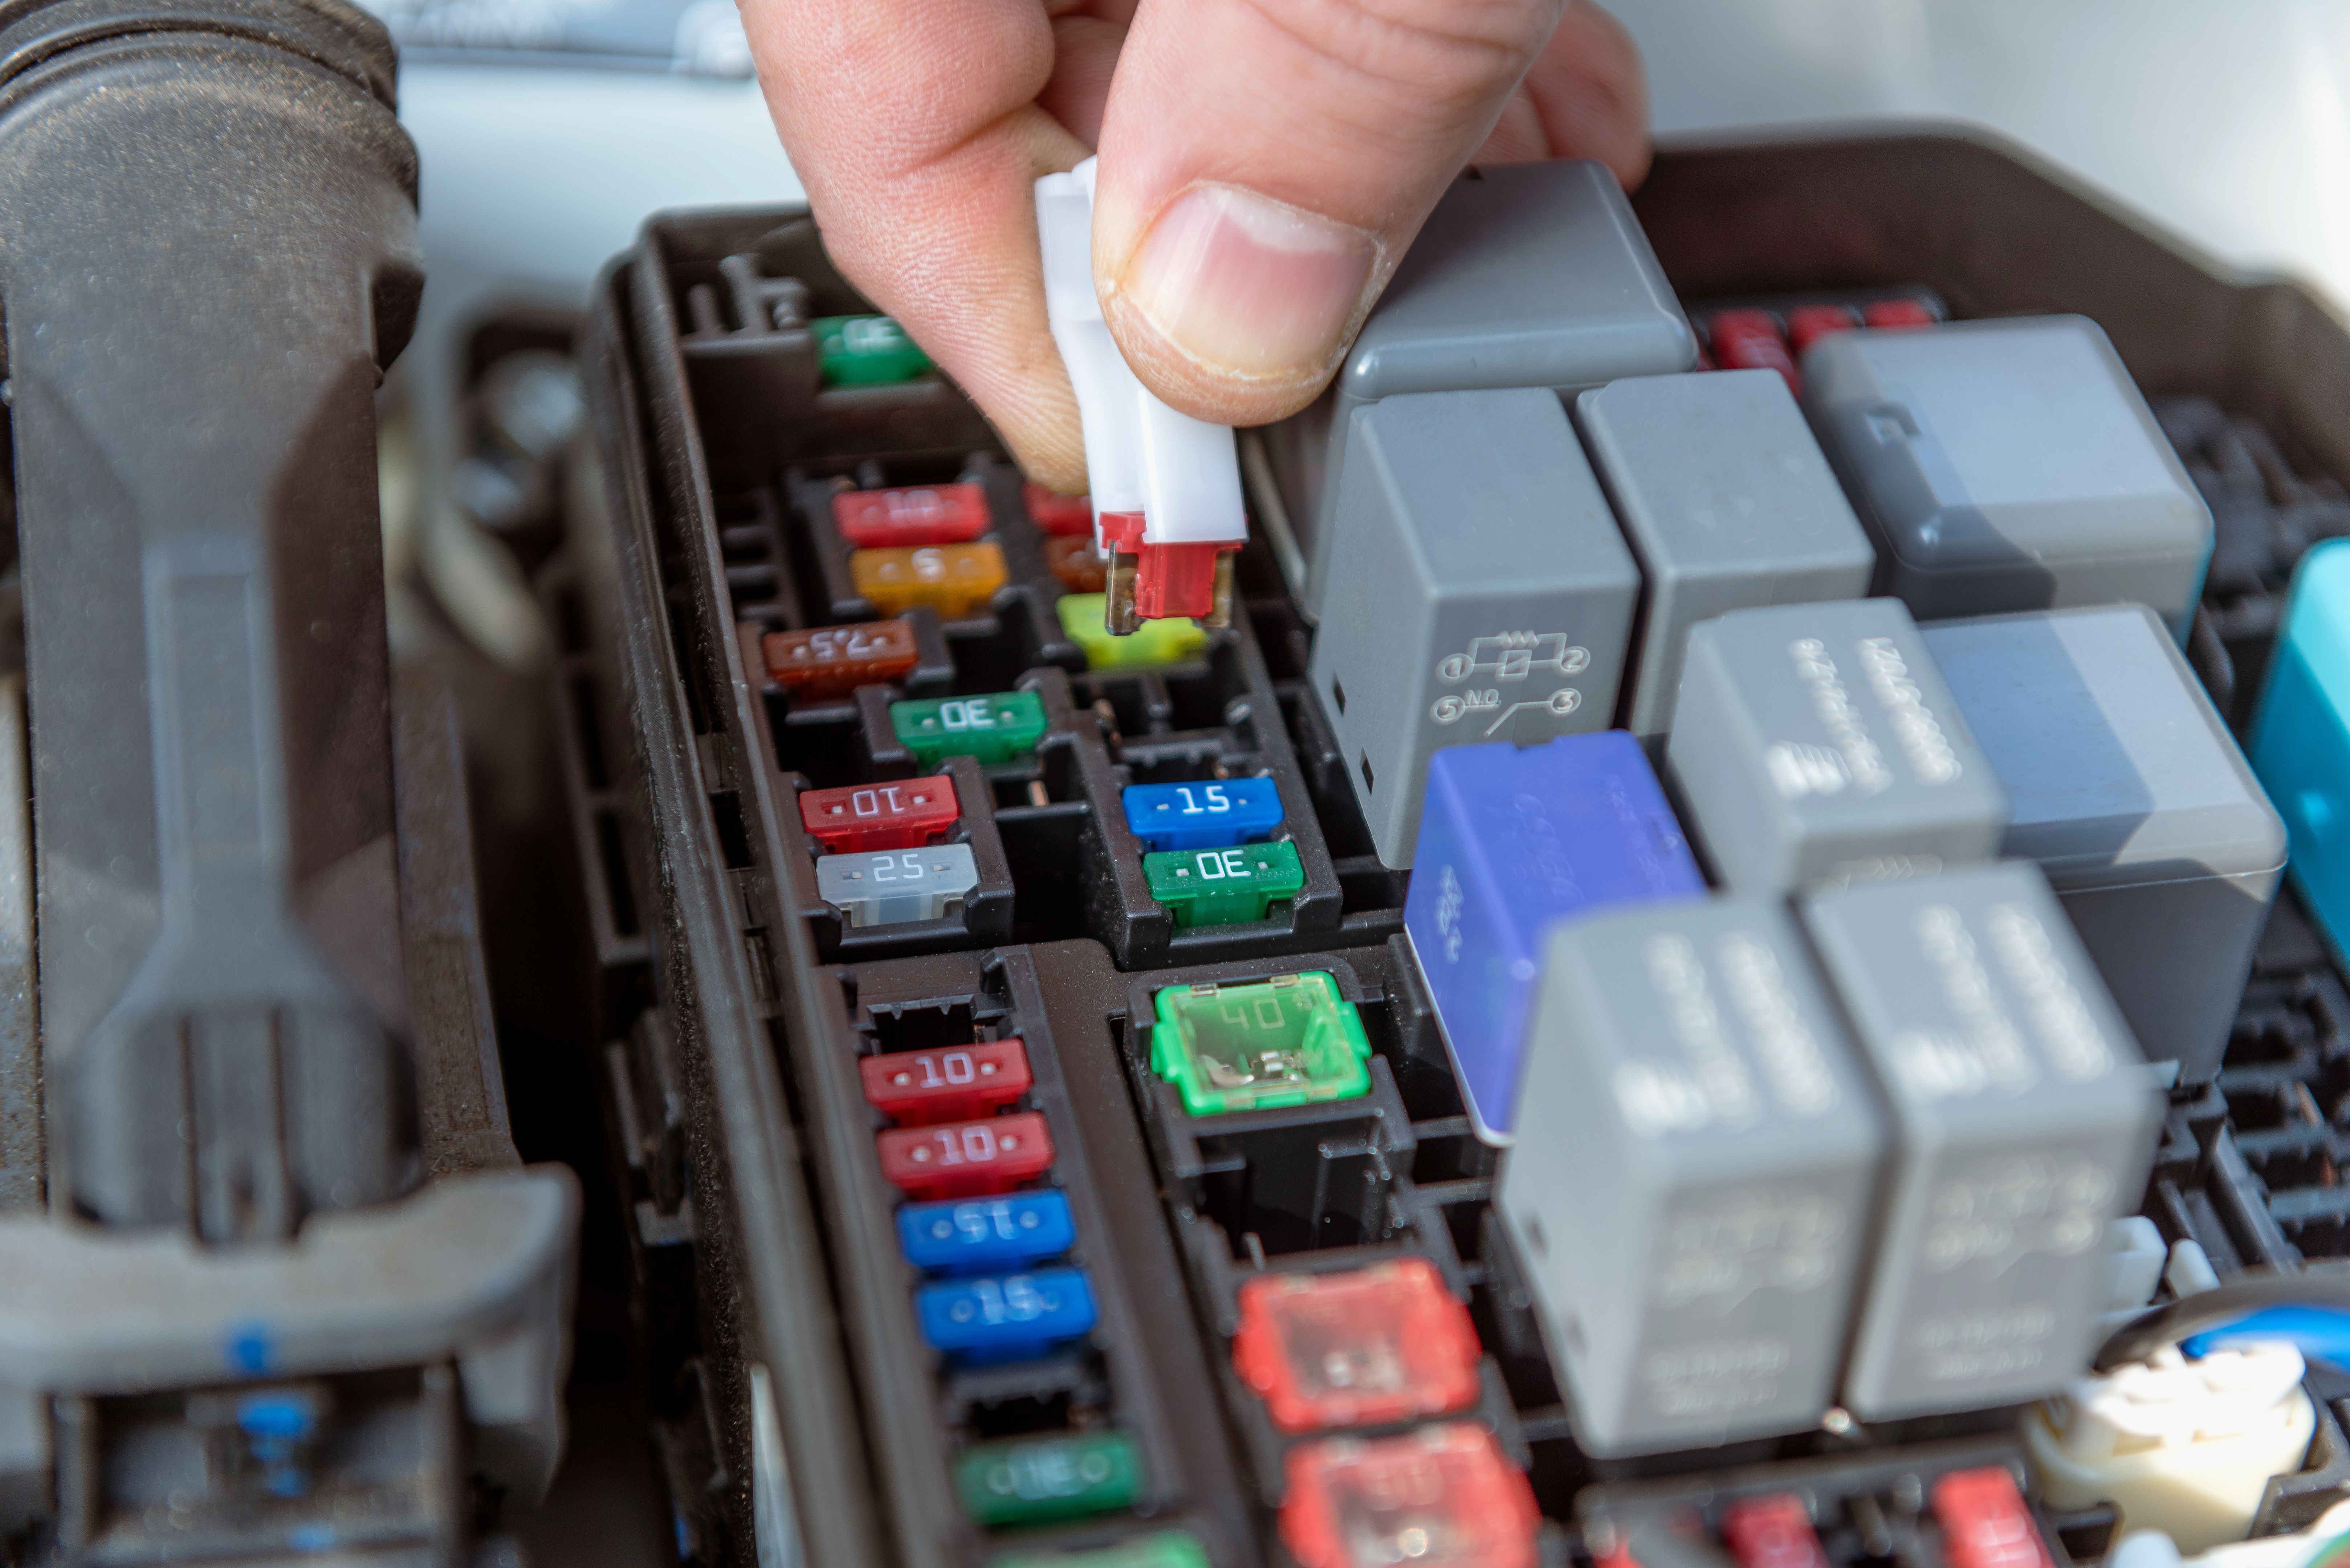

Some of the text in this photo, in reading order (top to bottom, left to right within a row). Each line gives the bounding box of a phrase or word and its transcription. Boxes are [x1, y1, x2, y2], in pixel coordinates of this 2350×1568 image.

[911, 547, 946, 584] 5
[1176, 785, 1230, 814] 15
[872, 853, 924, 882] 25
[1219, 998, 1286, 1030] 40
[915, 1053, 975, 1089] 10
[933, 1125, 998, 1166] 10
[973, 1275, 1043, 1326] 15
